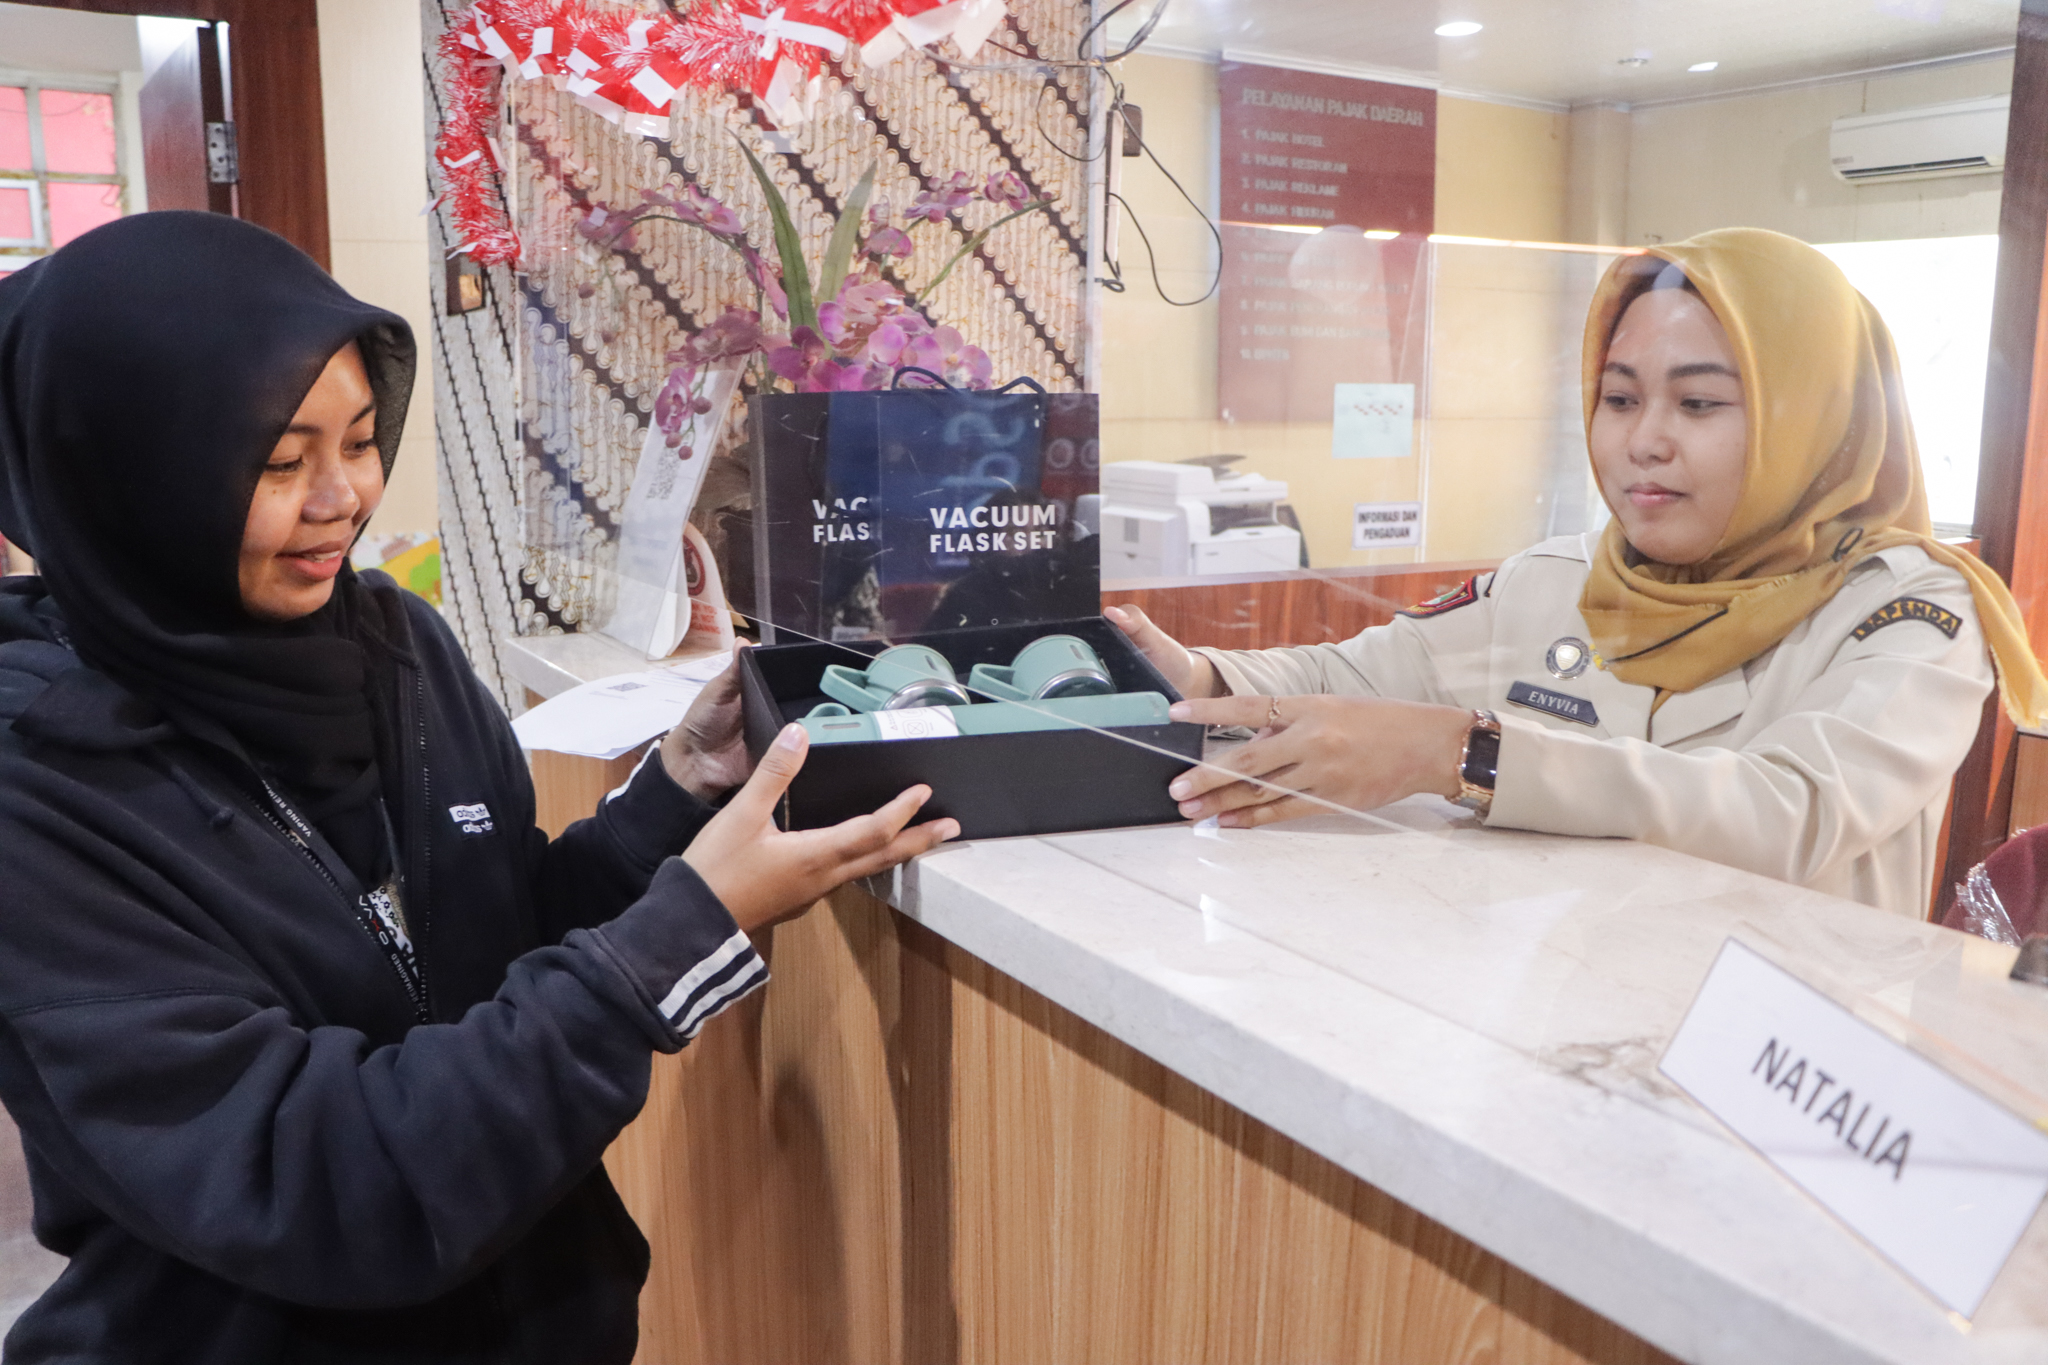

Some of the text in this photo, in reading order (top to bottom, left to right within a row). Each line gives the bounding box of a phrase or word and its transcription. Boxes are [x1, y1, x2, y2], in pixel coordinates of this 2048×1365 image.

[1327, 98, 1368, 120] PAJAK
[1370, 105, 1423, 127] DAERAH
[930, 505, 1056, 529] VACUUM
[1358, 510, 1418, 524] INFORMASI DAN
[930, 530, 1056, 553] FLASK SET
[1363, 527, 1410, 540] PENGADUAN
[1527, 691, 1579, 715] ENYVIA
[262, 779, 312, 838] VAPING REIM
[1751, 1036, 1914, 1182] NATALIA
